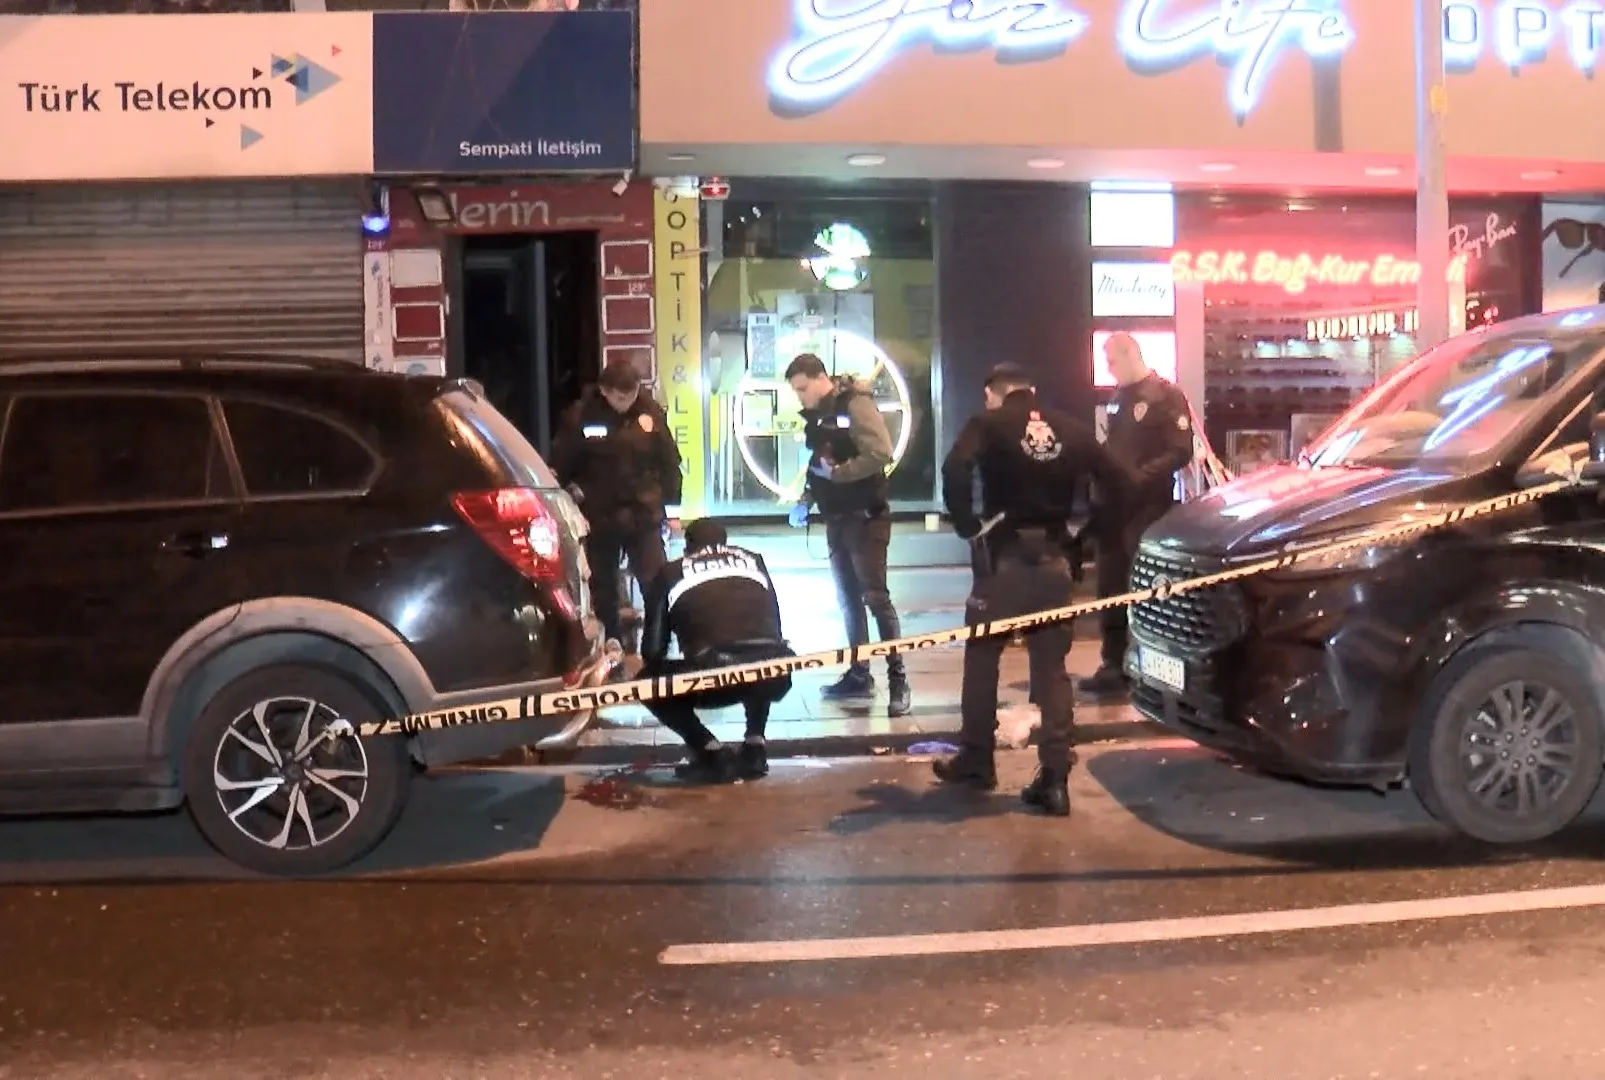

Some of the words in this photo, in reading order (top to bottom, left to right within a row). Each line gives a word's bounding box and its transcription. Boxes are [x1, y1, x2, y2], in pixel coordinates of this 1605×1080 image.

[18, 82, 101, 112] Türk
[114, 80, 273, 112] Telekom
[458, 140, 533, 158] Sempati
[536, 137, 602, 158] İletişim
[1370, 253, 1468, 285] Emli
